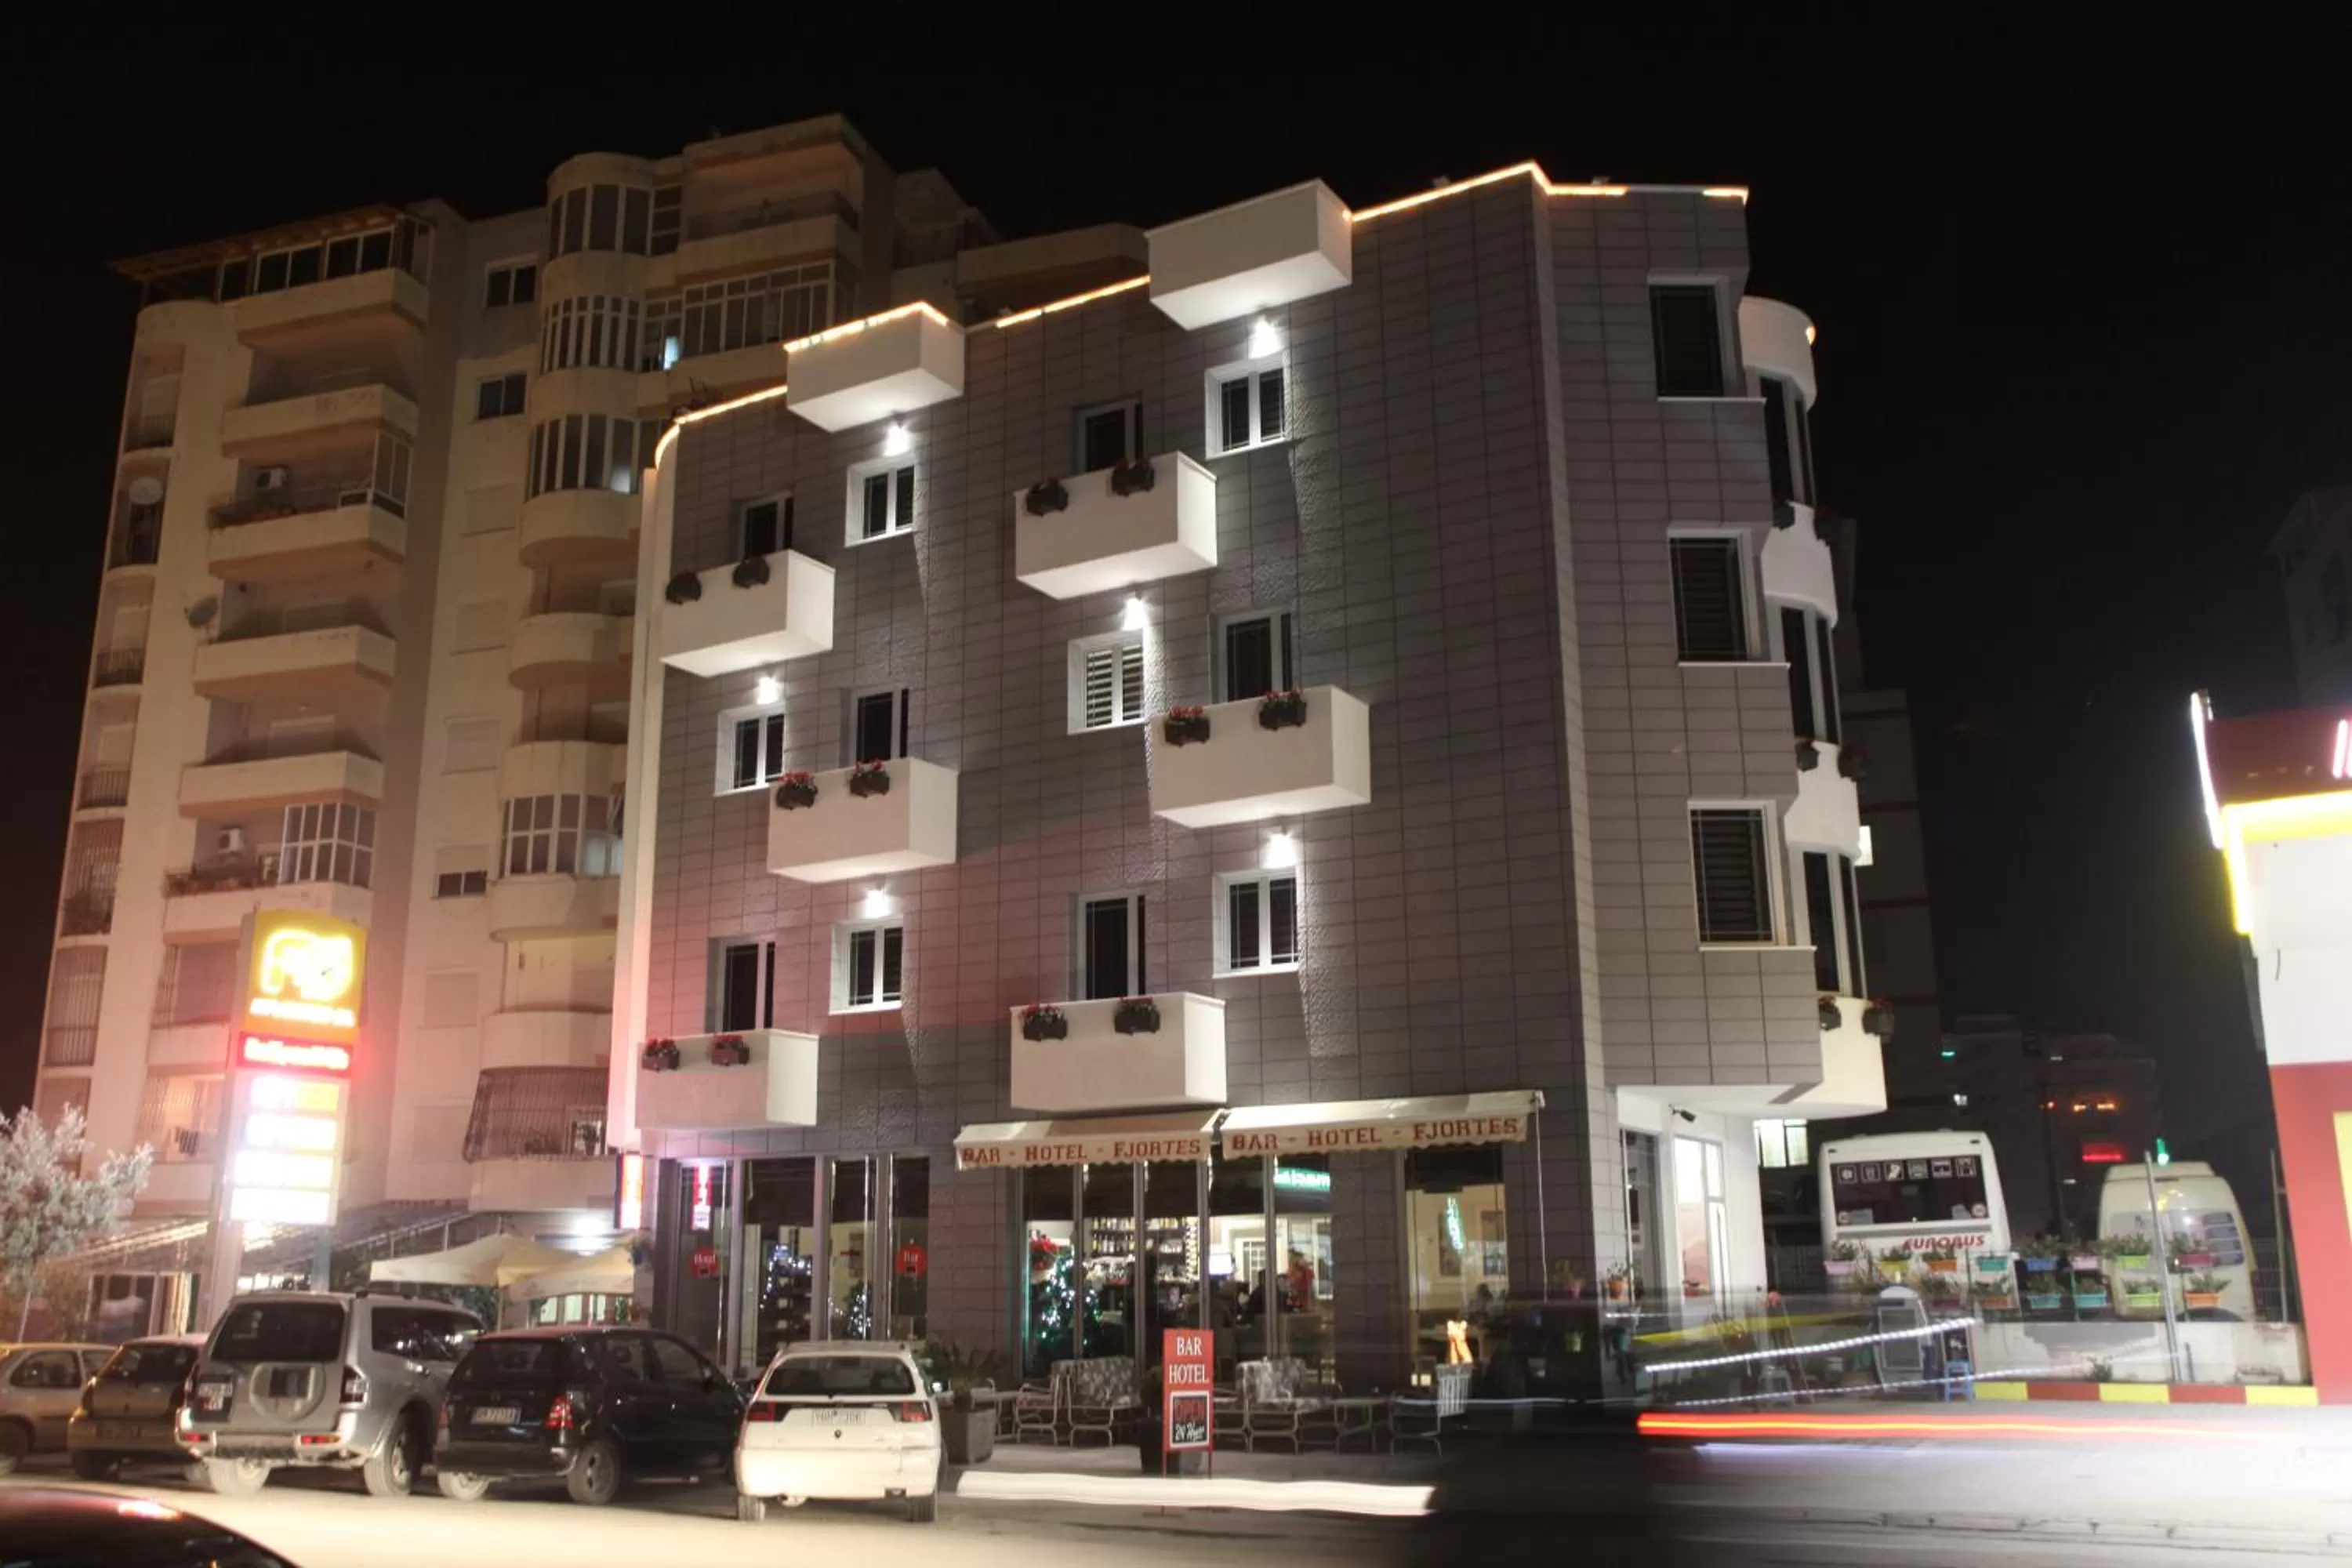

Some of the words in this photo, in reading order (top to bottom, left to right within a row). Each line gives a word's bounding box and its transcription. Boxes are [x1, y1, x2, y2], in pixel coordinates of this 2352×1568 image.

[1231, 1133, 1279, 1151] BAR
[1307, 1127, 1382, 1147] HOTEL
[1413, 1116, 1518, 1141] FJORTES
[962, 1147, 1000, 1163] BAR
[1025, 1145, 1088, 1162] HOTEL
[1113, 1139, 1202, 1158] FJORTES
[1177, 1336, 1203, 1356] BAR
[1169, 1363, 1210, 1385] HOTEL
